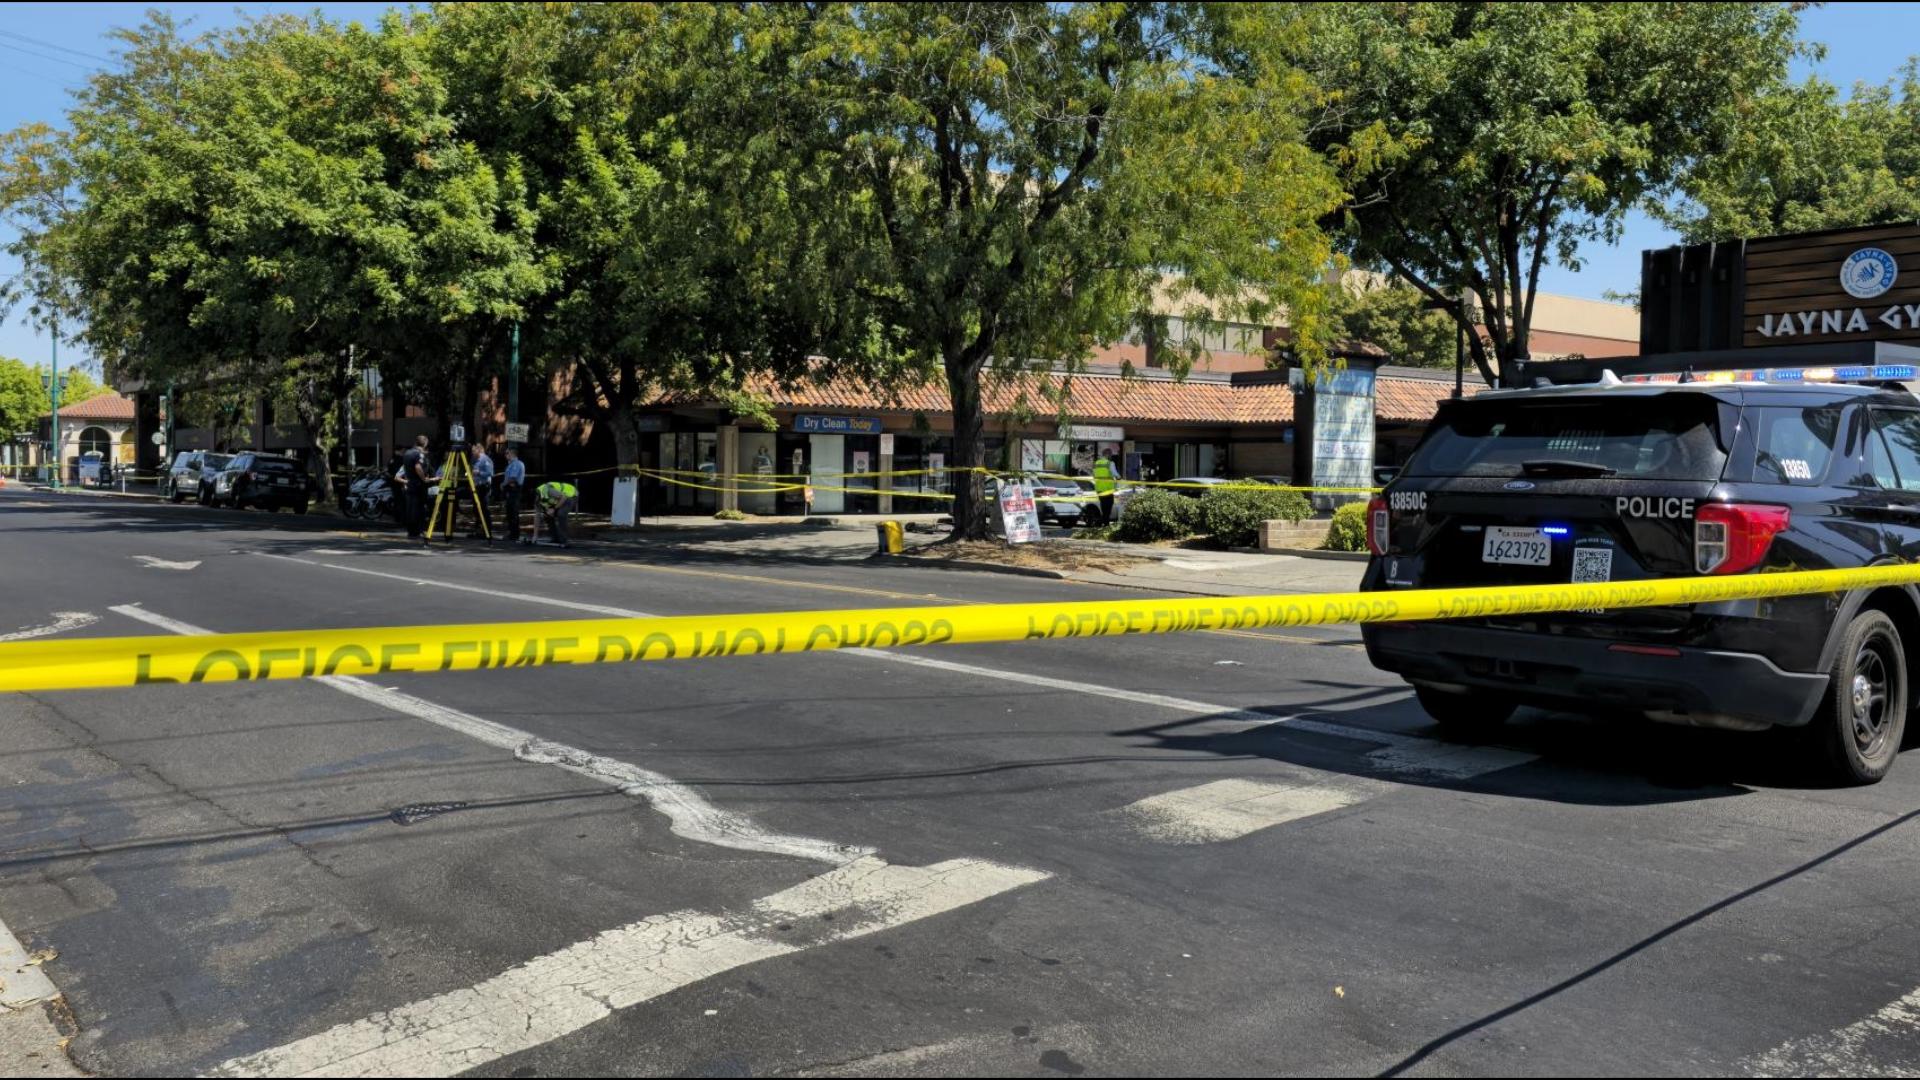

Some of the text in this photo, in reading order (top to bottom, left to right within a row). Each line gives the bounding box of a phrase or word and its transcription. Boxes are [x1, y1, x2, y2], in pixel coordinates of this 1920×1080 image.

[1756, 307, 1869, 337] JAYNA
[803, 417, 818, 430] Dry
[822, 417, 846, 429] Clean
[1781, 459, 1811, 479] 13850
[1390, 491, 1427, 510] 13850C
[1616, 497, 1694, 519] POLICE
[1487, 540, 1547, 561] 1623792
